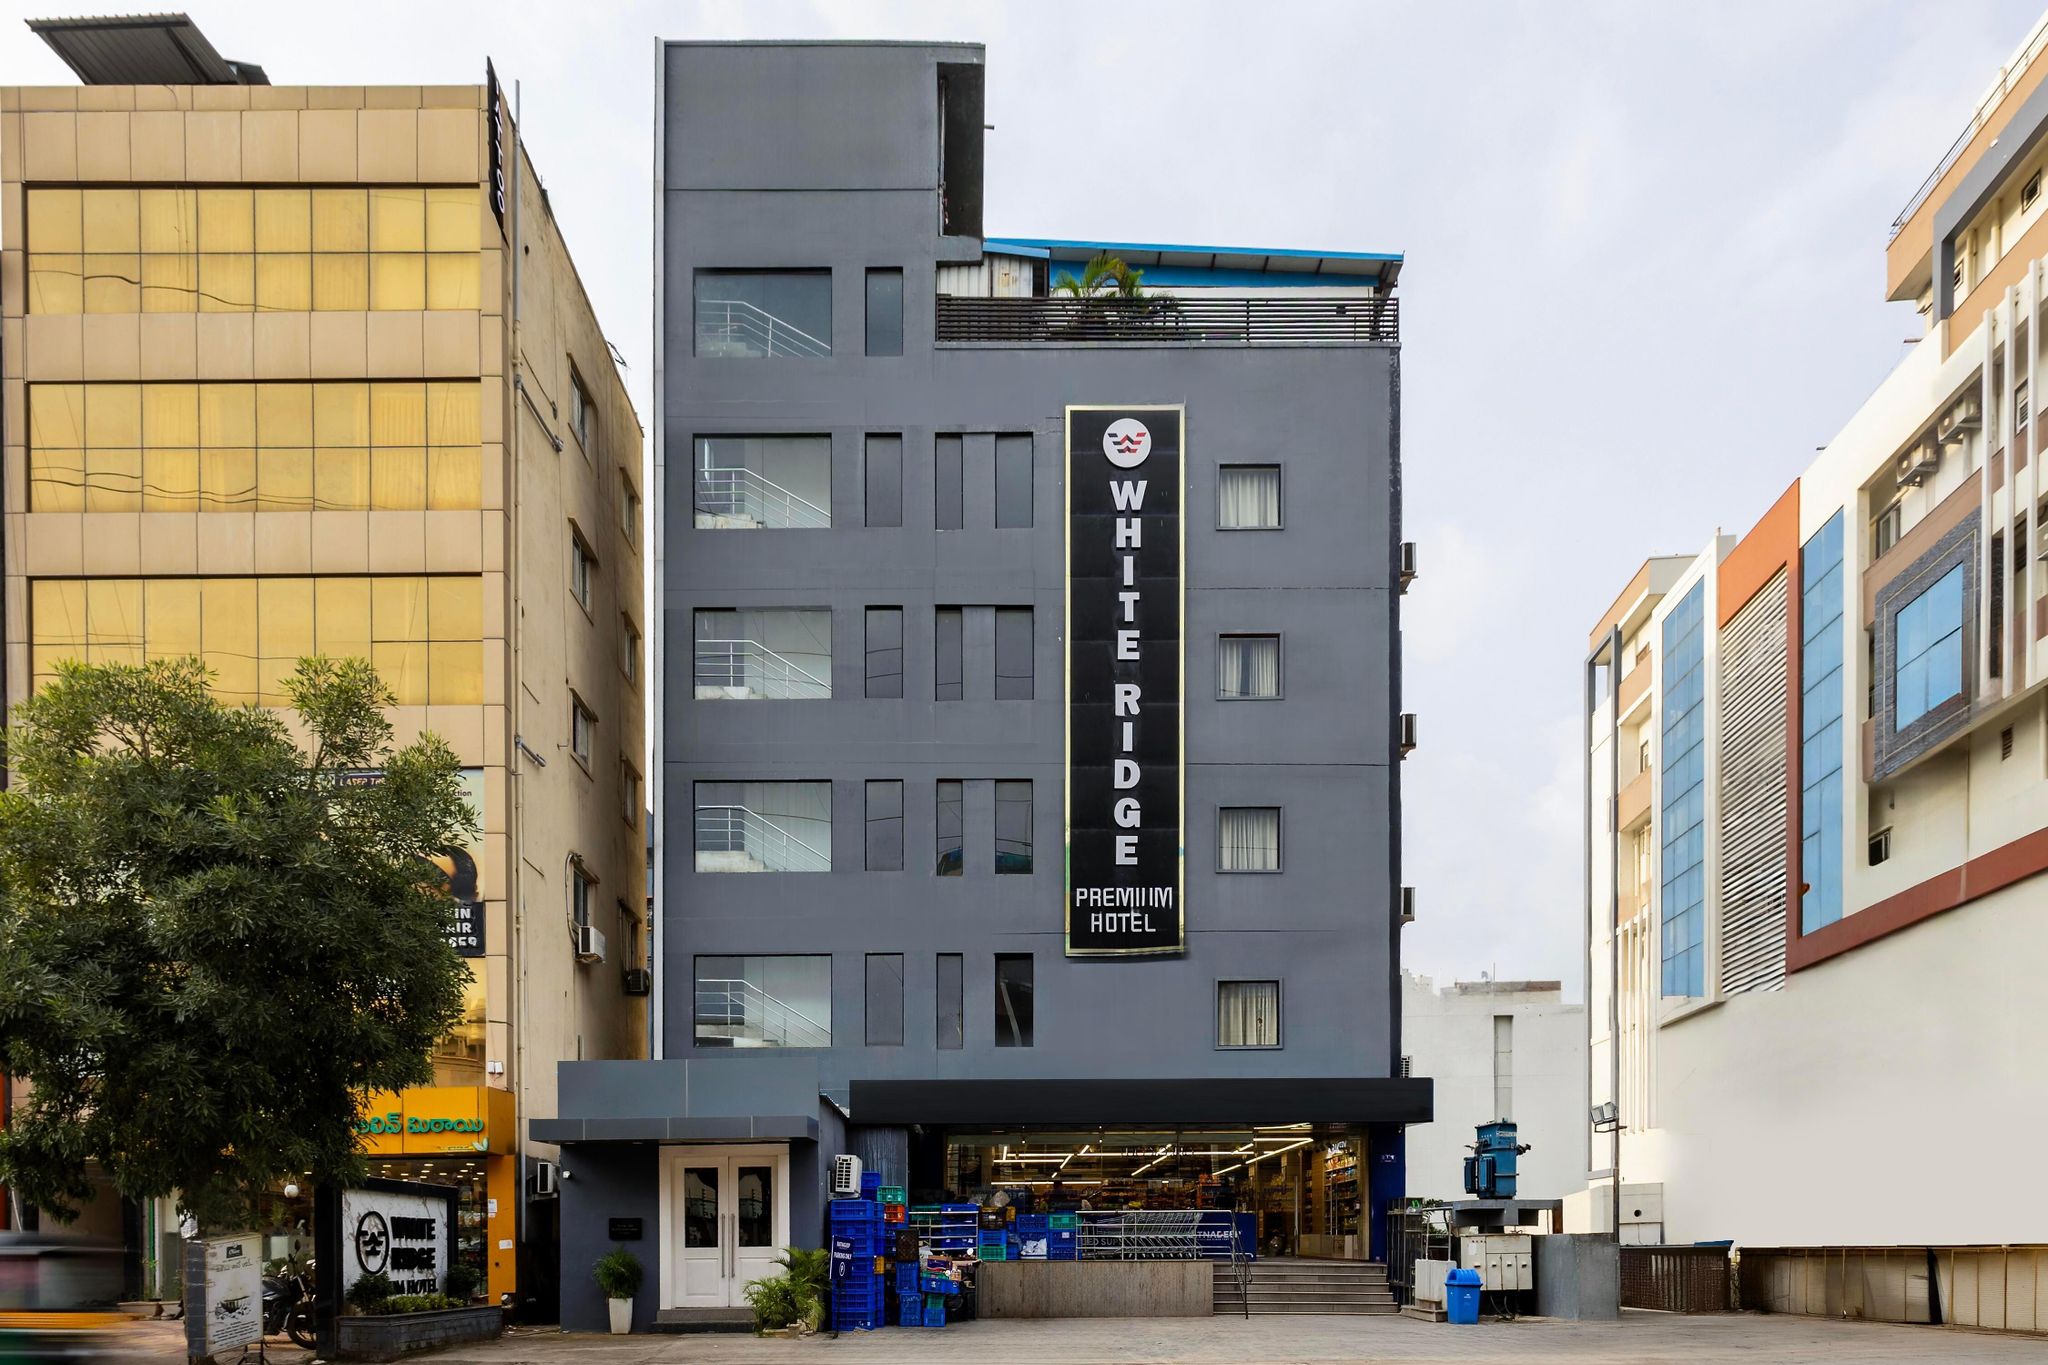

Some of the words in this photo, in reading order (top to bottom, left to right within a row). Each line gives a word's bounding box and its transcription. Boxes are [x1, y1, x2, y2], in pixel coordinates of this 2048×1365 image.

[1110, 479, 1148, 660] WHITE
[1113, 683, 1142, 865] RIDGE
[1091, 911, 1157, 932] HOTEL
